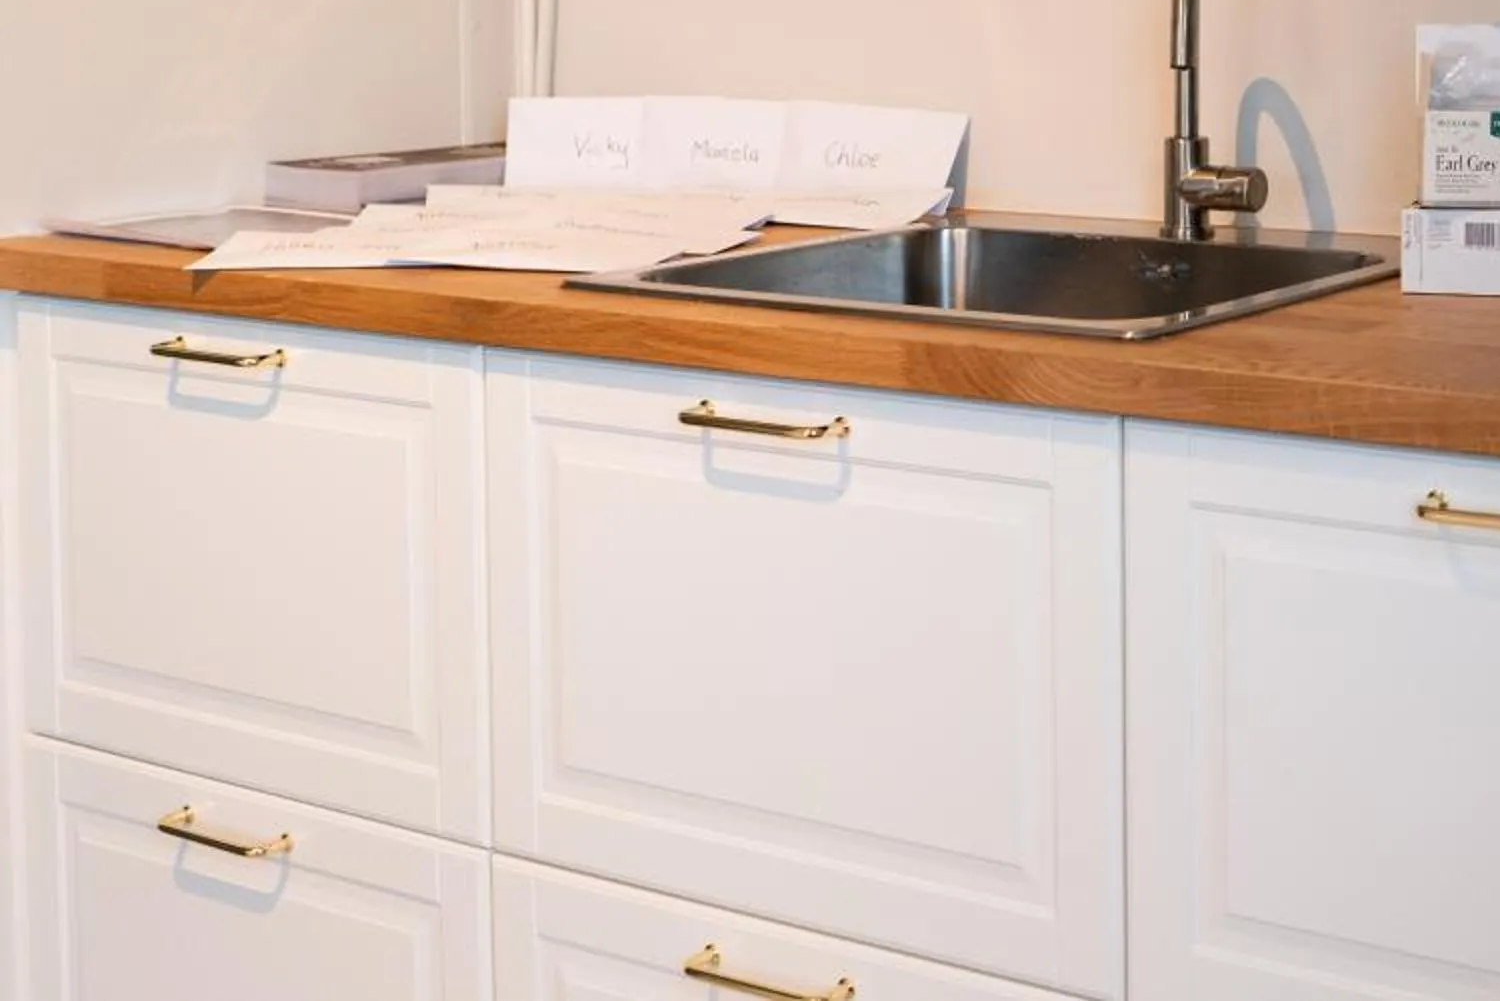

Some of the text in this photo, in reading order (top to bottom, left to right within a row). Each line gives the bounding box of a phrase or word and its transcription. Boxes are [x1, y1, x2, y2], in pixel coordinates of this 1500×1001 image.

[573, 131, 629, 170] Vky
[1435, 153, 1498, 175] Earl Grey
